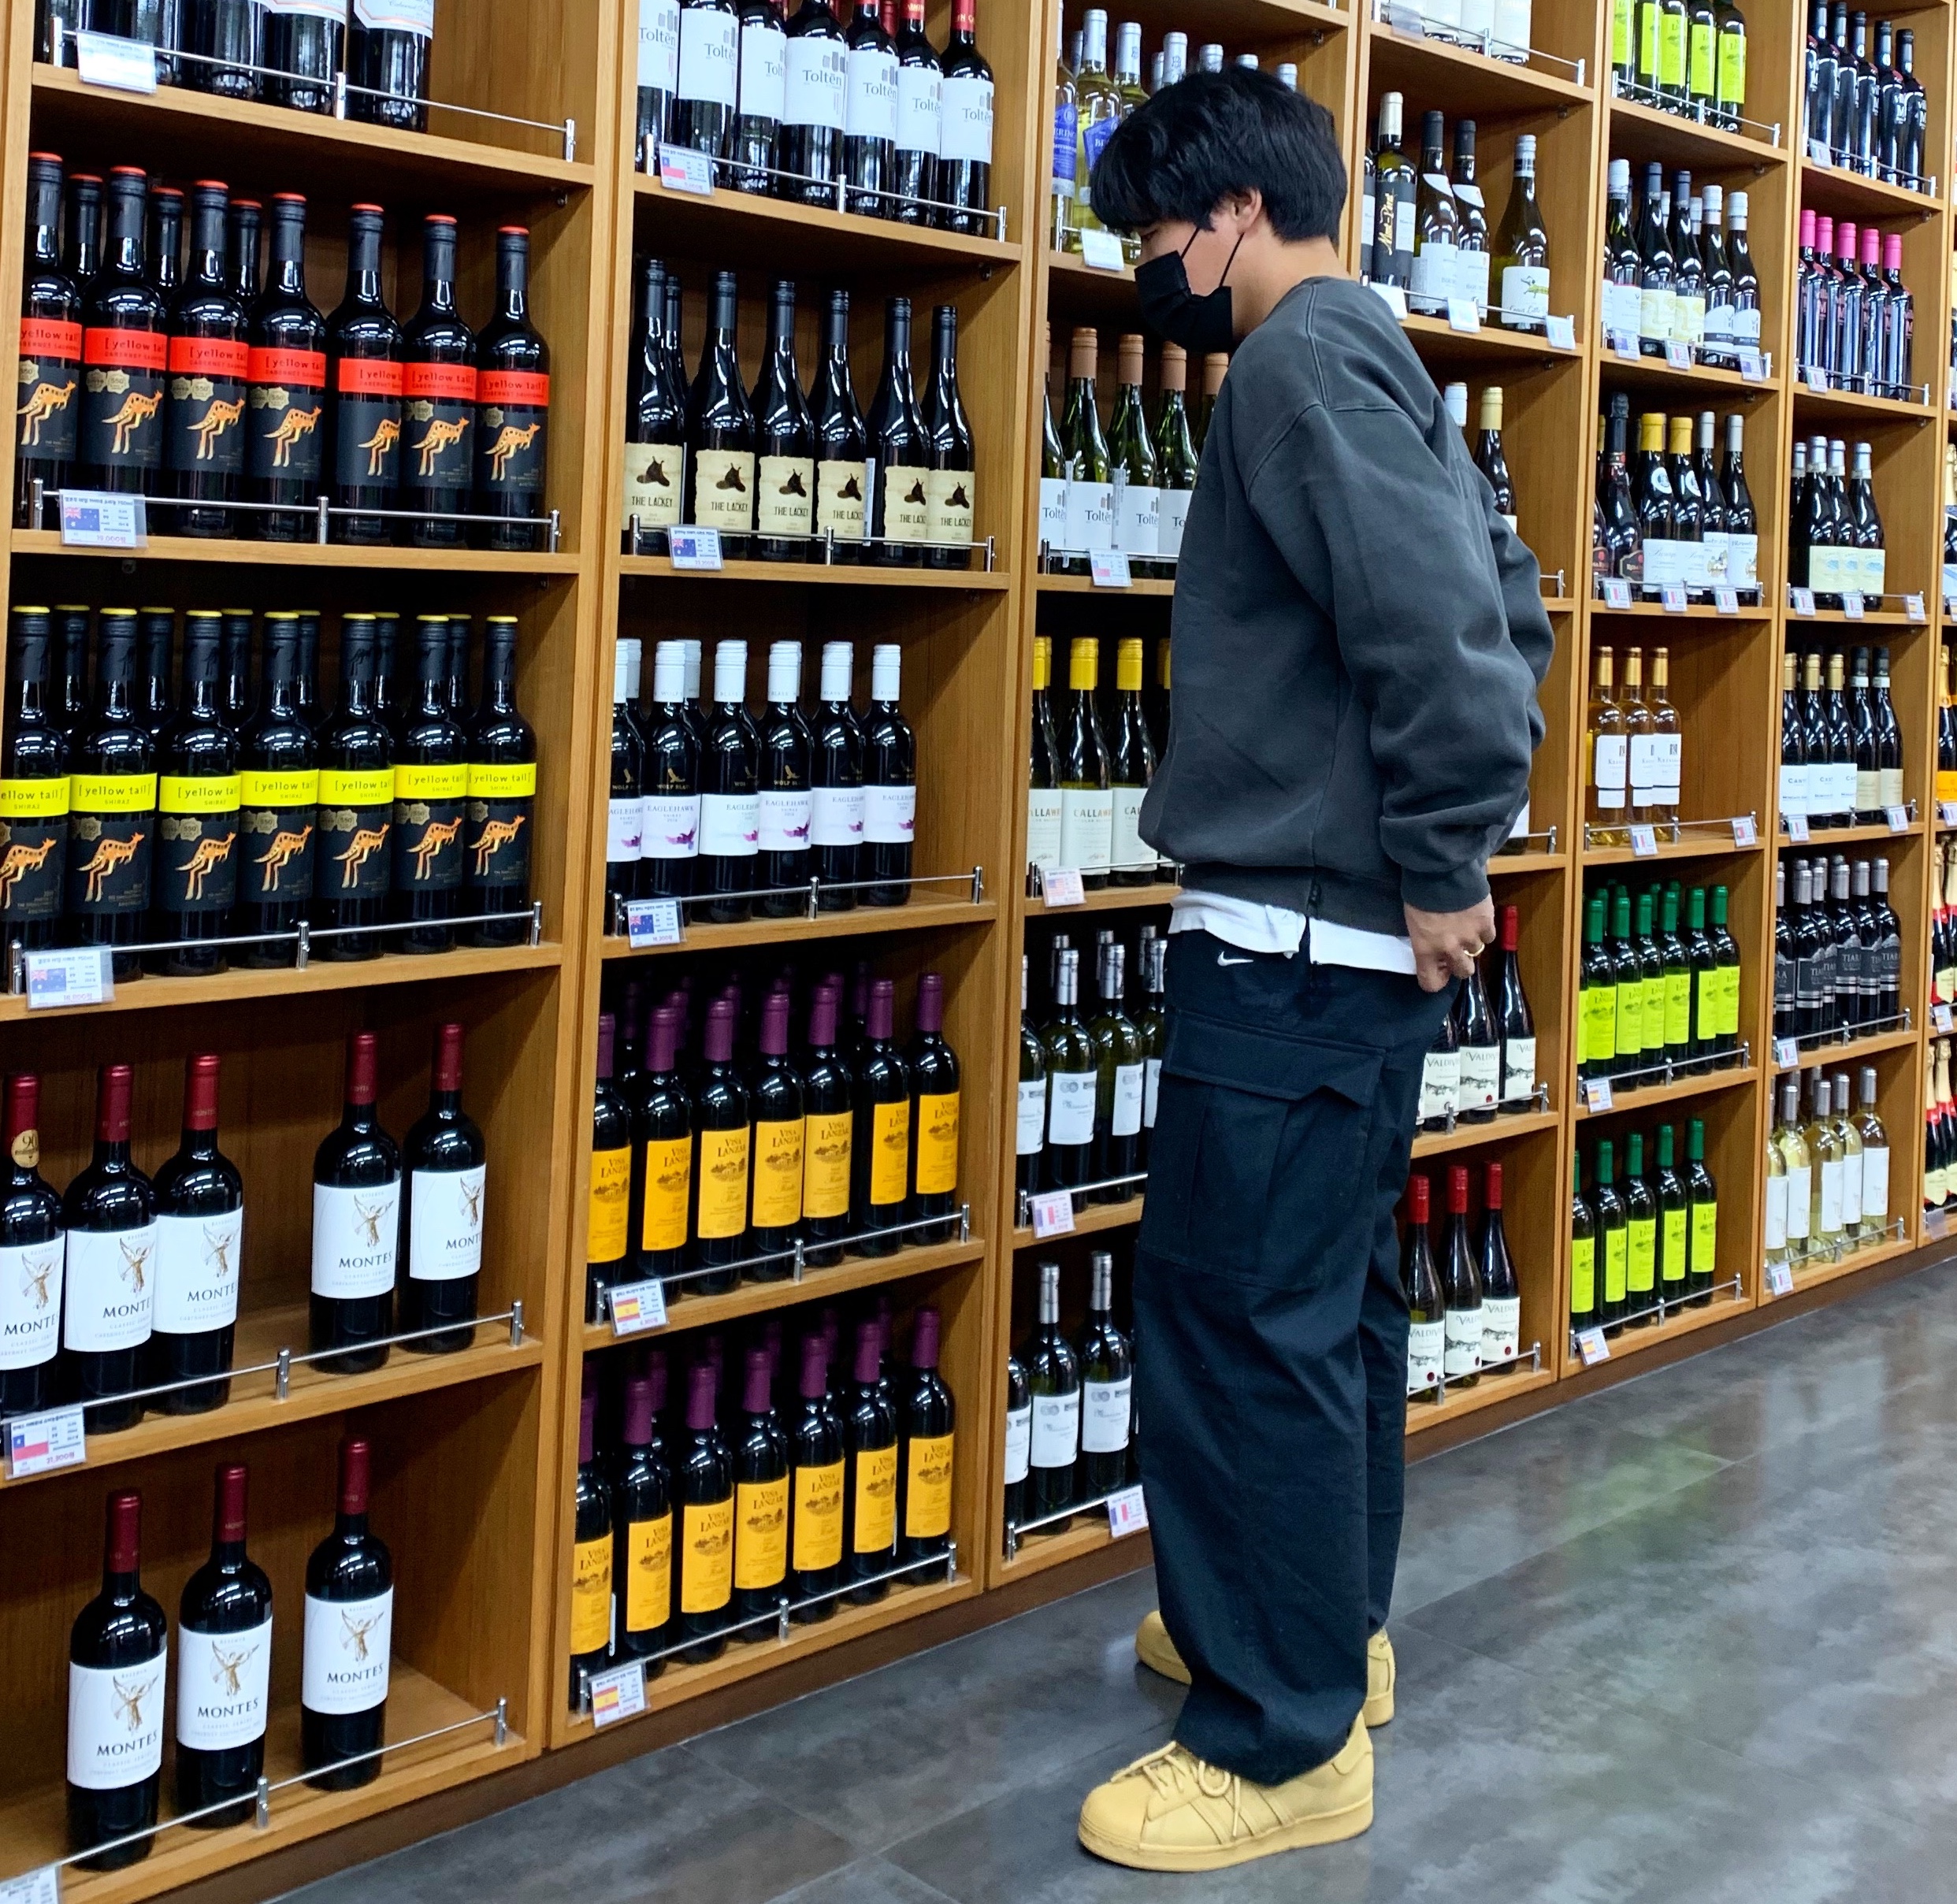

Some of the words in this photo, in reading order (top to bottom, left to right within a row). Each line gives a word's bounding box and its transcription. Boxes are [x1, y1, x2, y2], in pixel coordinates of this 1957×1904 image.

[338, 1250, 392, 1269] MONTES
[186, 1282, 238, 1303] MONTE
[326, 1662, 384, 1684] MONTES
[196, 1698, 258, 1719] MONTES
[96, 1729, 158, 1757] MONTES
